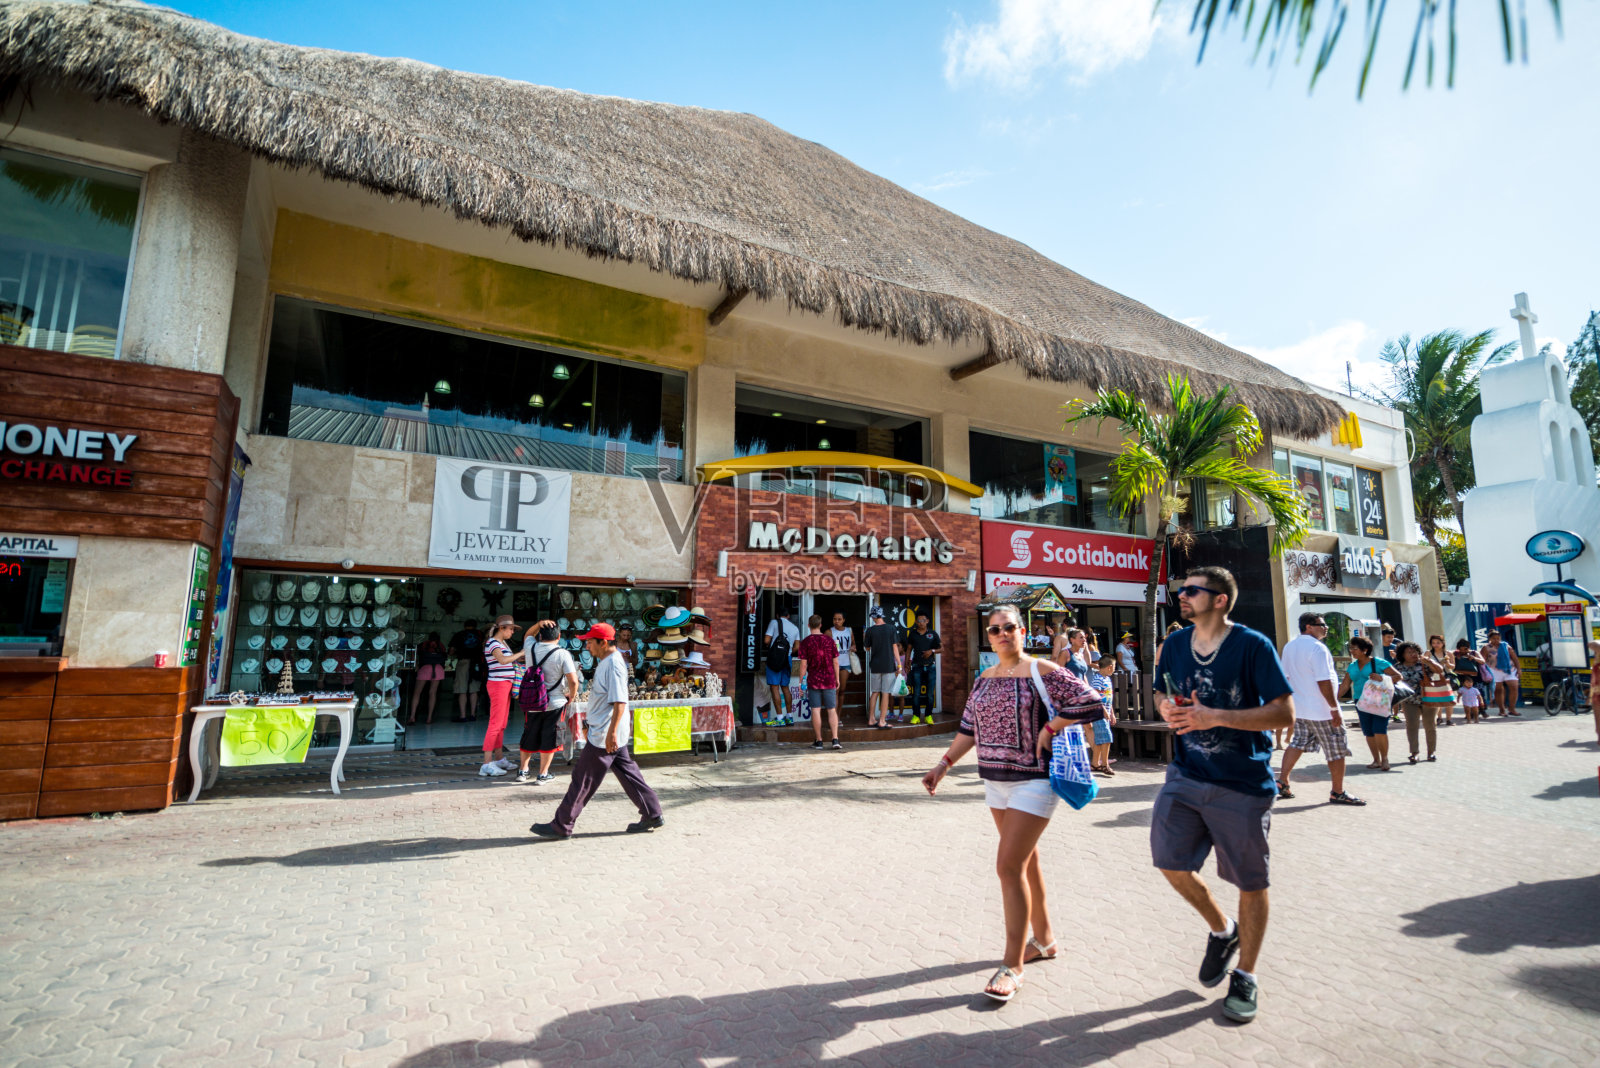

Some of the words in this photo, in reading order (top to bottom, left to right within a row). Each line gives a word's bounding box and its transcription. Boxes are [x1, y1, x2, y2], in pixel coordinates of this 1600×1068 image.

[0, 460, 133, 487] CHANGE
[1364, 498, 1382, 525] 24
[0, 537, 58, 551] APITAL
[450, 532, 551, 553] JEWELRY
[749, 521, 953, 564] McDonald's
[464, 553, 496, 562] FAMILY
[499, 556, 545, 565] TRADITION
[1043, 540, 1148, 570] Scotiabank
[1072, 583, 1083, 594] 24
[1470, 604, 1488, 612] ATM
[747, 600, 757, 669] STRES
[836, 636, 850, 651] NY
[792, 699, 811, 720] $13
